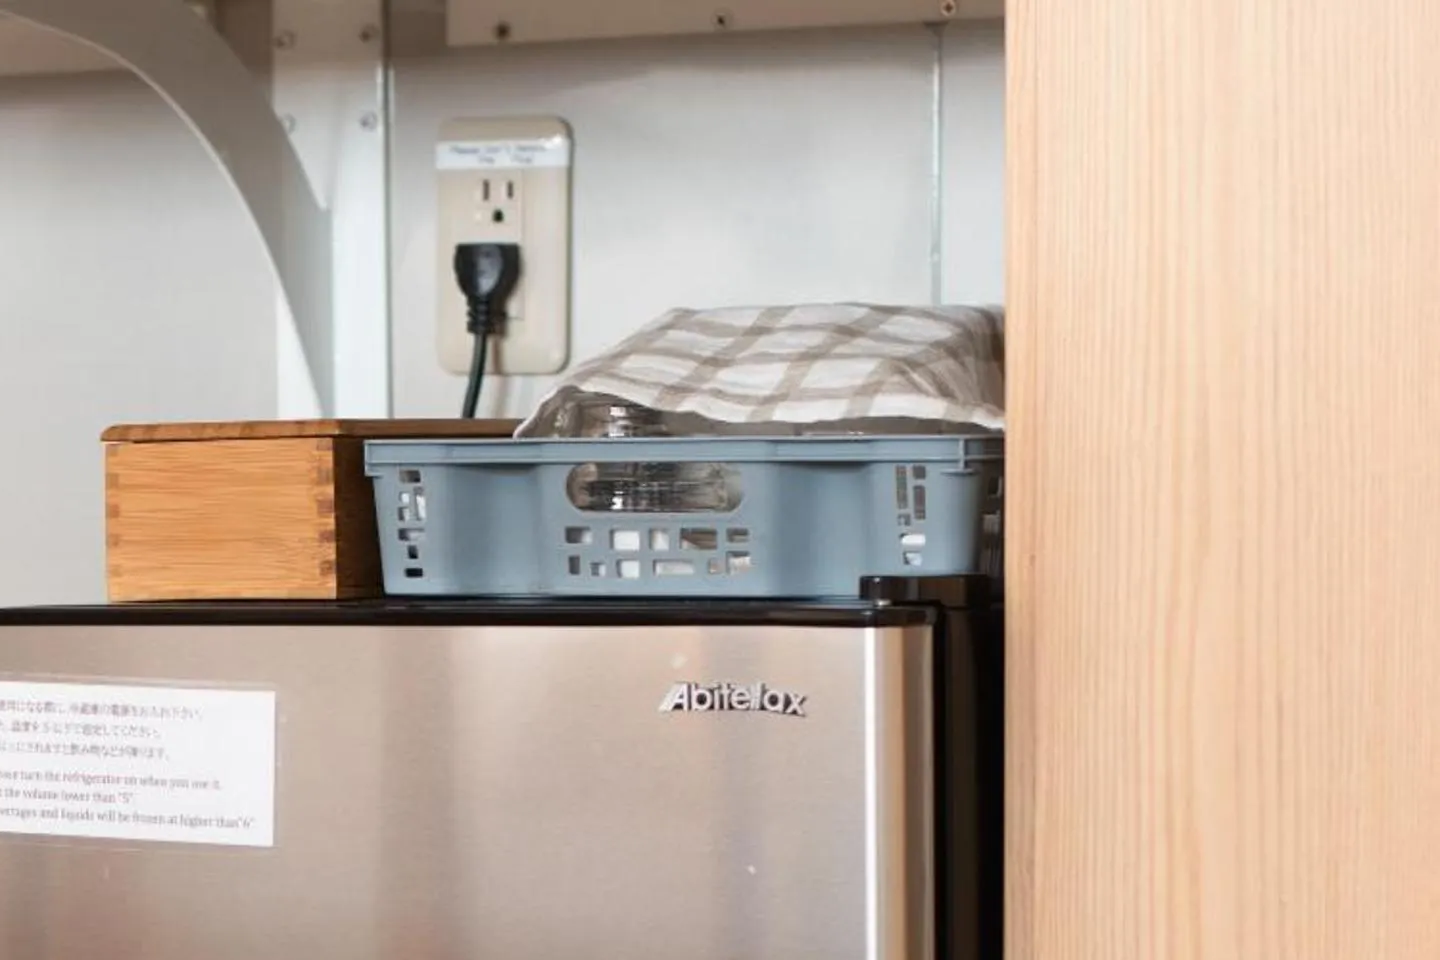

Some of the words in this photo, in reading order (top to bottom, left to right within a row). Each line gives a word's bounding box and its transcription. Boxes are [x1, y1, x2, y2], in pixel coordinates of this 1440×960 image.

[658, 681, 807, 717] Abitelax
[20, 769, 43, 781] turn
[44, 769, 60, 781] the
[62, 770, 121, 785] refrigerator
[124, 776, 137, 785] on
[140, 773, 167, 787] when
[170, 777, 190, 789] you
[191, 779, 209, 789] use
[4, 786, 21, 798] the
[22, 787, 59, 799] volume
[61, 788, 90, 801] lower
[92, 791, 117, 803] than
[40, 805, 59, 819] and
[61, 807, 95, 822] liquids
[96, 809, 116, 822] will
[117, 810, 131, 822] be
[132, 810, 166, 824] frozen
[180, 812, 212, 828] higher
